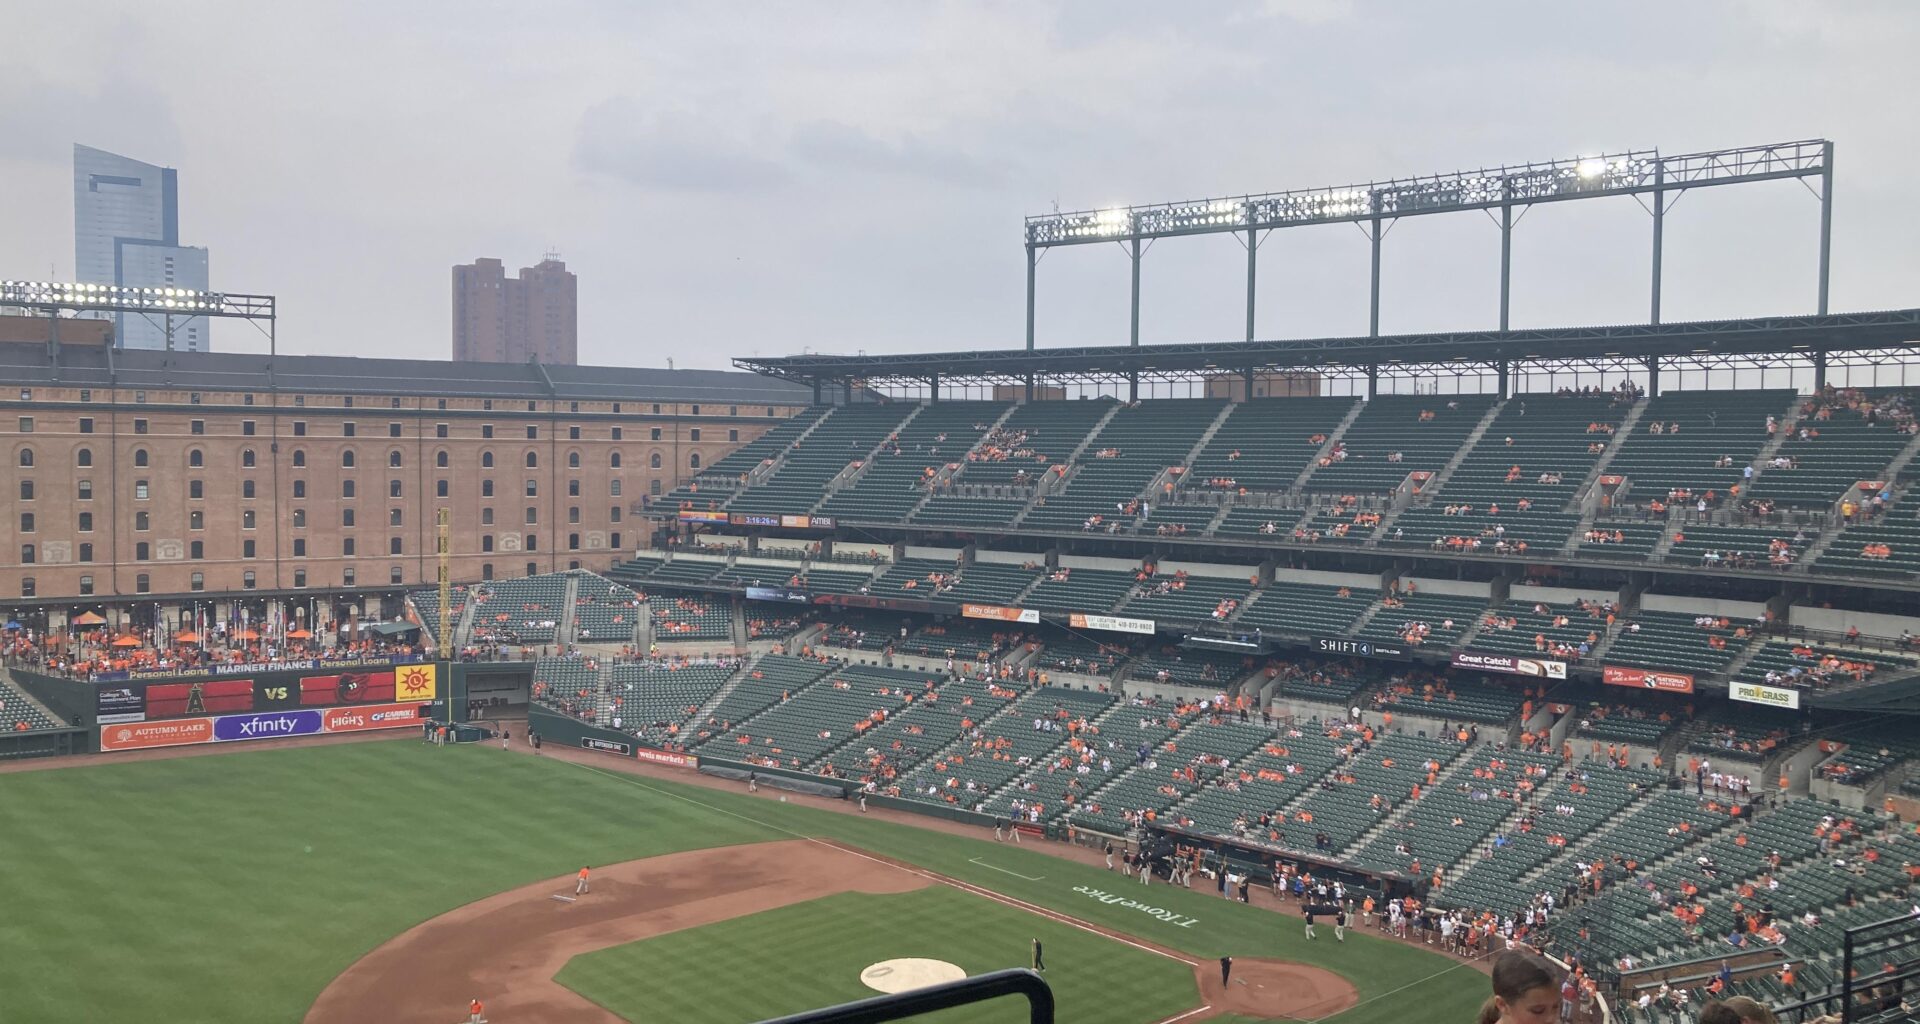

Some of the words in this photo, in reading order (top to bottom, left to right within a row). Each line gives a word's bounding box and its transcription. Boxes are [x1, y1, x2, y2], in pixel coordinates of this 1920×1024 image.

[1320, 639, 1358, 653] SHIFT
[1459, 654, 1483, 664] Great
[1483, 656, 1512, 667] Catch!
[129, 668, 176, 680] Personal
[178, 667, 209, 676] Loans
[216, 663, 266, 674] MARINER
[267, 660, 313, 670] FINANCE
[319, 658, 361, 668] Personal
[362, 656, 390, 666] Loans
[1738, 687, 1755, 697] PRO
[1761, 690, 1790, 702] GRASS
[239, 716, 298, 735] xfinity
[331, 715, 364, 728] HIGH'S
[135, 726, 178, 736] AUTUMN
[180, 723, 206, 732] LAKE
[638, 751, 655, 760] weis
[655, 753, 684, 764] markets
